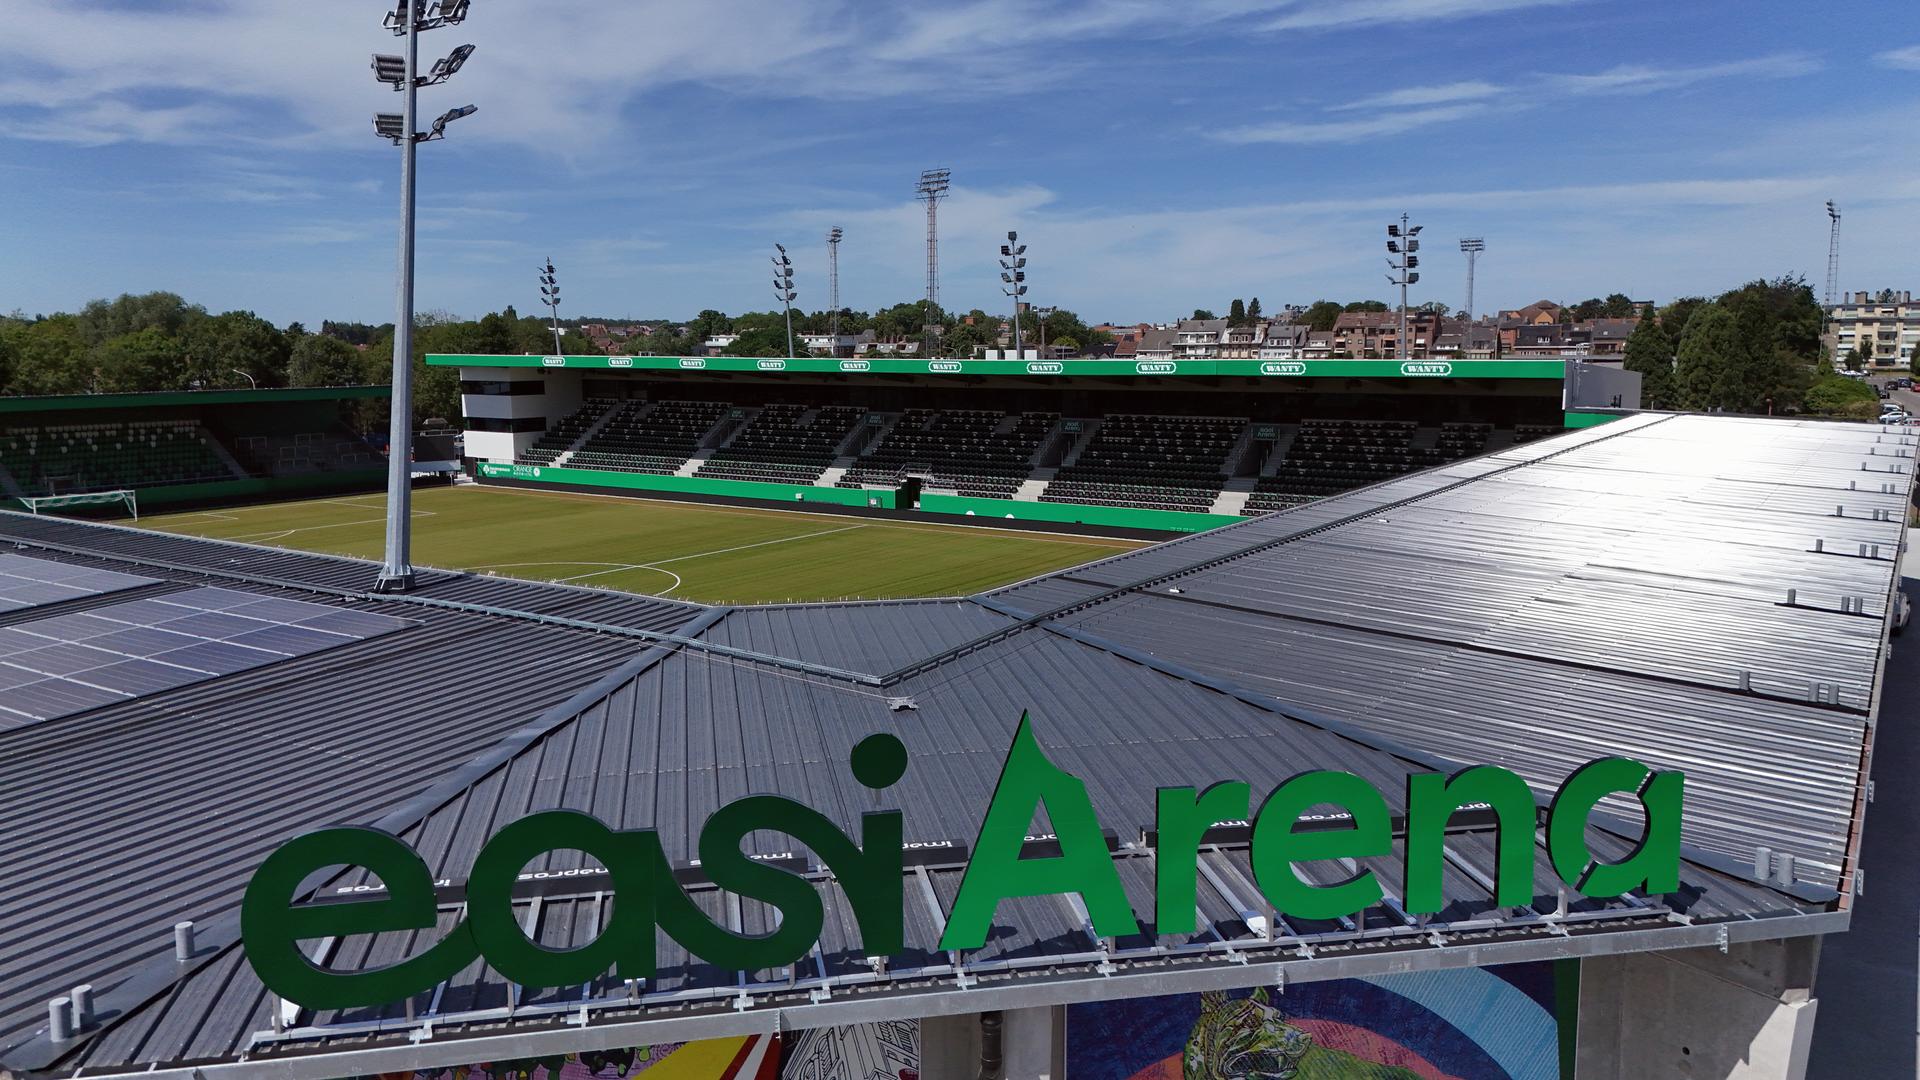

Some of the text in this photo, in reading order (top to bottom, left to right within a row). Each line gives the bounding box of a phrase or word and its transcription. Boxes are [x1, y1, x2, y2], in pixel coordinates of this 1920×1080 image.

[1407, 365, 1446, 373] WANTY
[241, 708, 1684, 1010] easi Arena
